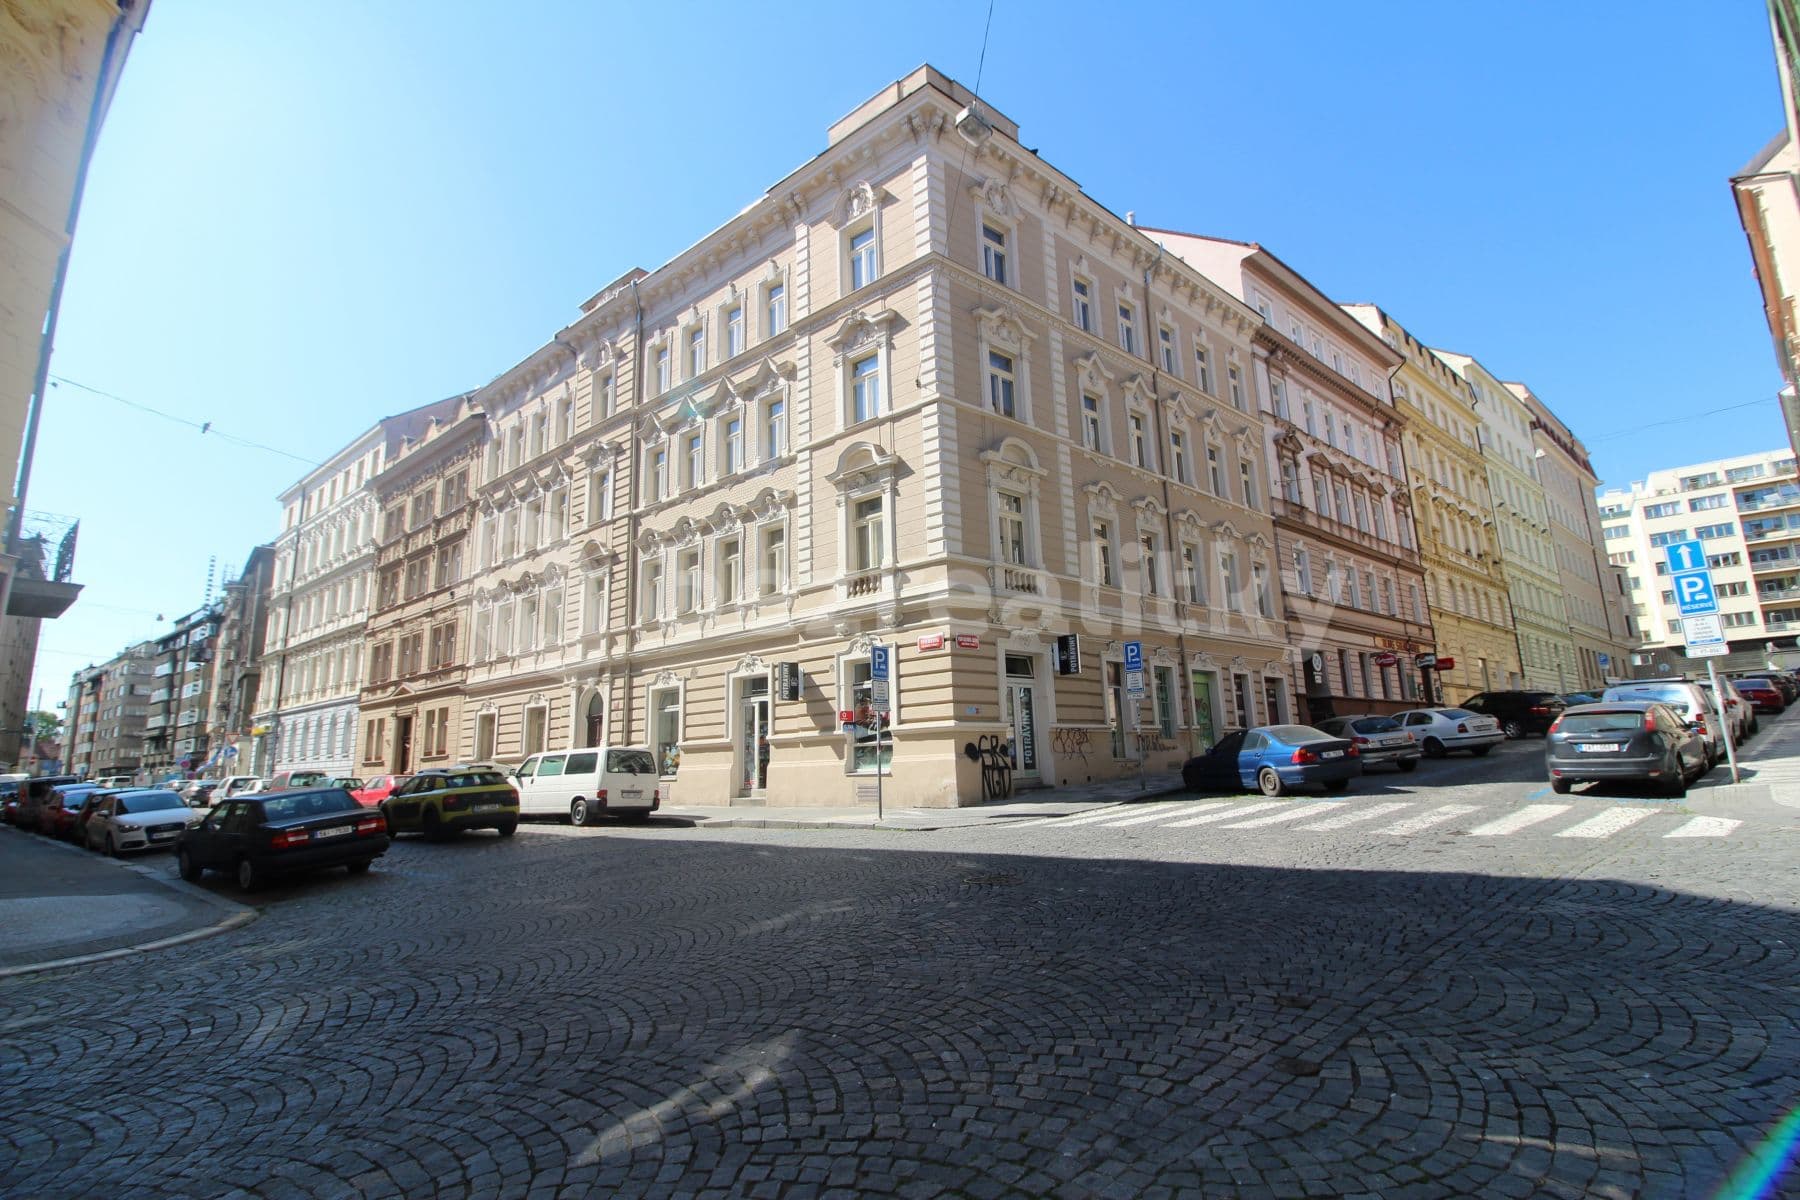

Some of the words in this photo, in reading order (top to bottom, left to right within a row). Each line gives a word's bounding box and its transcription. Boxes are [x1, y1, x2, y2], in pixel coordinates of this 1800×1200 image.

[1680, 577, 1704, 602] P
[875, 651, 886, 669] P
[1069, 636, 1077, 673] POTRAVINY
[1127, 645, 1138, 663] P
[782, 663, 790, 700] POTRAVINY
[1021, 709, 1033, 764] POTRAVINY
